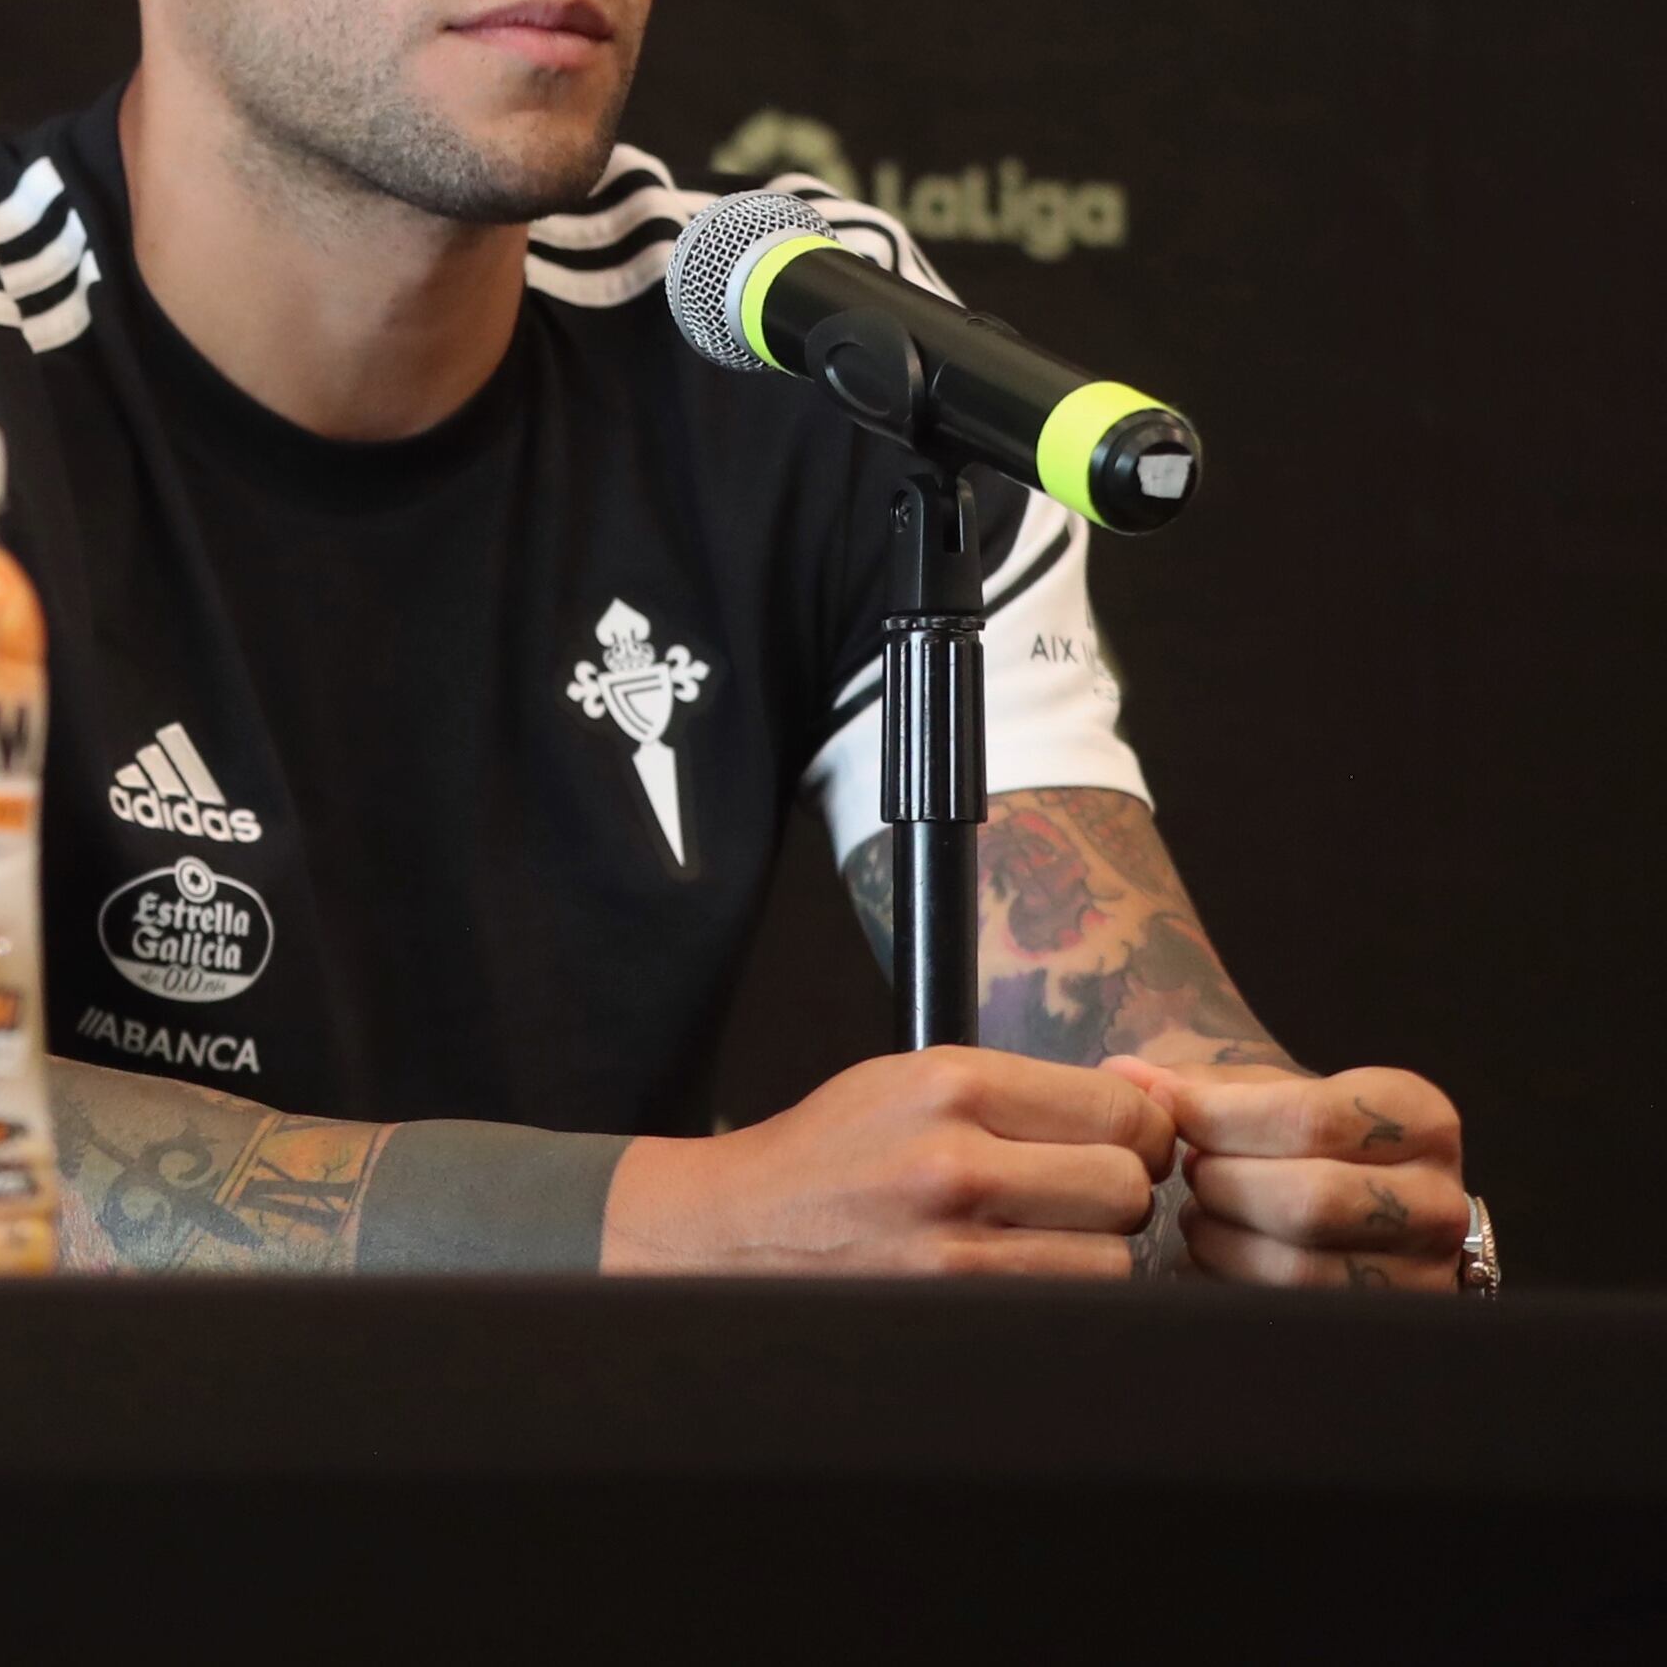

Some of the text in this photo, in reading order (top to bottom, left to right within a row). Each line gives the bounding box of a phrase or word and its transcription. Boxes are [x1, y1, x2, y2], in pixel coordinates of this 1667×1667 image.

[874, 155, 1130, 263] LaLiga
[1029, 632, 1079, 664] AIX
[107, 784, 264, 844] adidas
[131, 891, 251, 938] Estrella
[131, 925, 243, 971] Galicia
